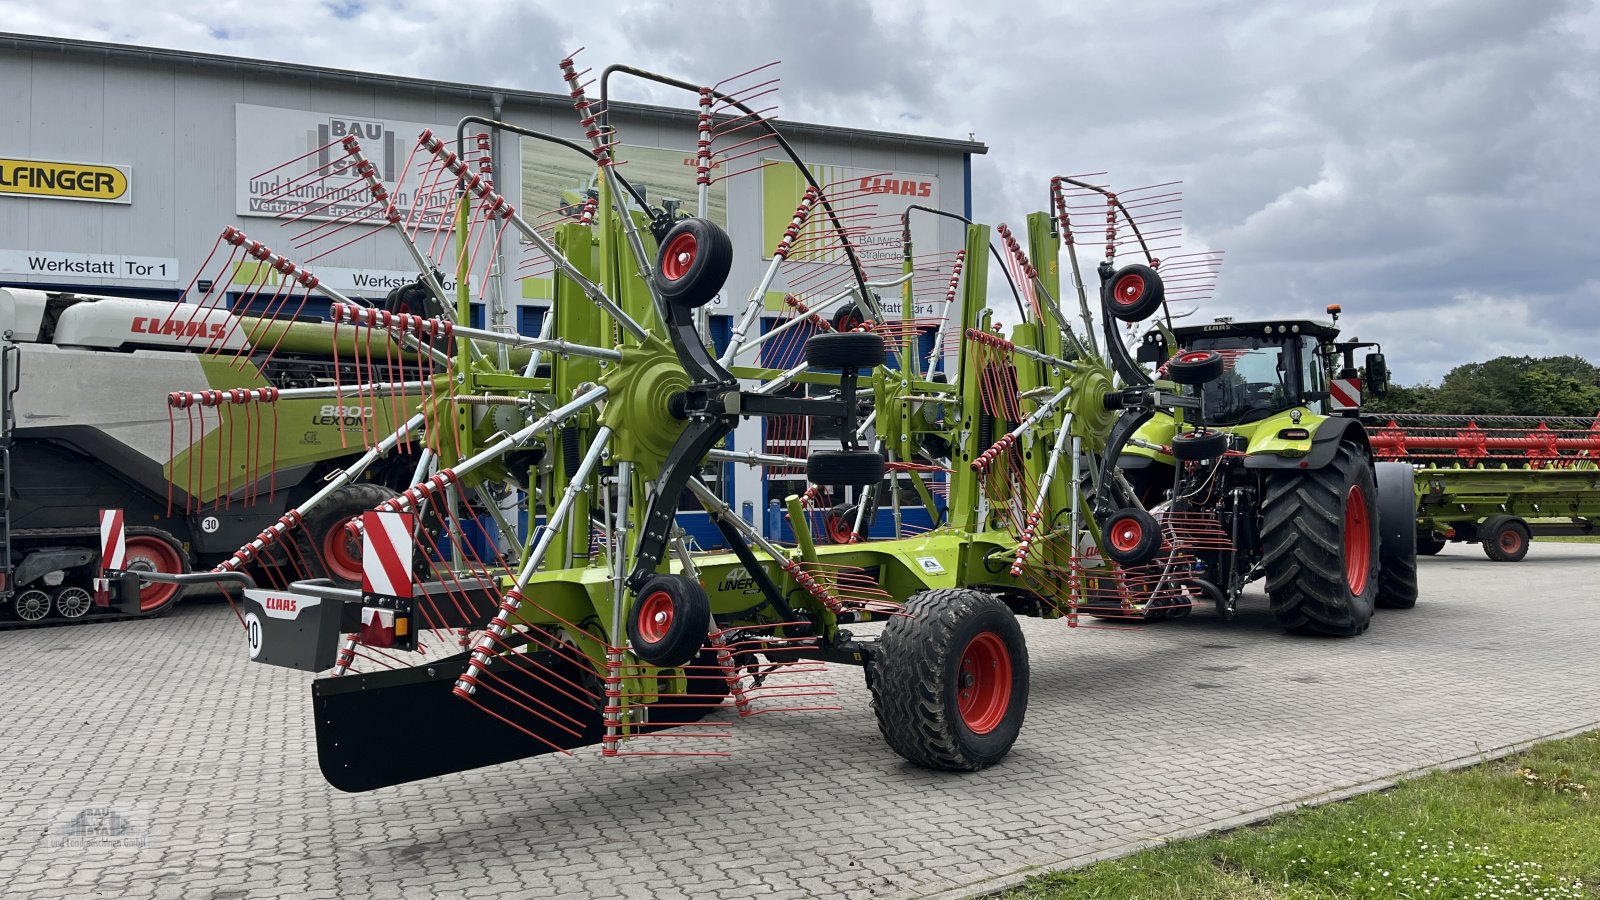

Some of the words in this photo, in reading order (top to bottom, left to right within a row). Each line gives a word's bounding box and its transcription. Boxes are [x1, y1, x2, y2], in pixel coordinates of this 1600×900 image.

[332, 120, 382, 140] BAU
[249, 175, 280, 196] und
[287, 178, 407, 206] Landmaschen
[860, 177, 932, 197] CLAAS
[251, 199, 307, 213] Vertrieb
[860, 236, 903, 247] BAUWES
[28, 256, 115, 274] Werkstatt
[125, 261, 154, 276] Tor
[159, 264, 166, 276] 1
[443, 280, 457, 291] or
[714, 293, 721, 304] 3
[926, 304, 933, 314] 4
[131, 317, 226, 339] CLAAS
[204, 519, 217, 530] 30
[718, 579, 754, 592] LINER
[266, 598, 297, 612] CLAAS
